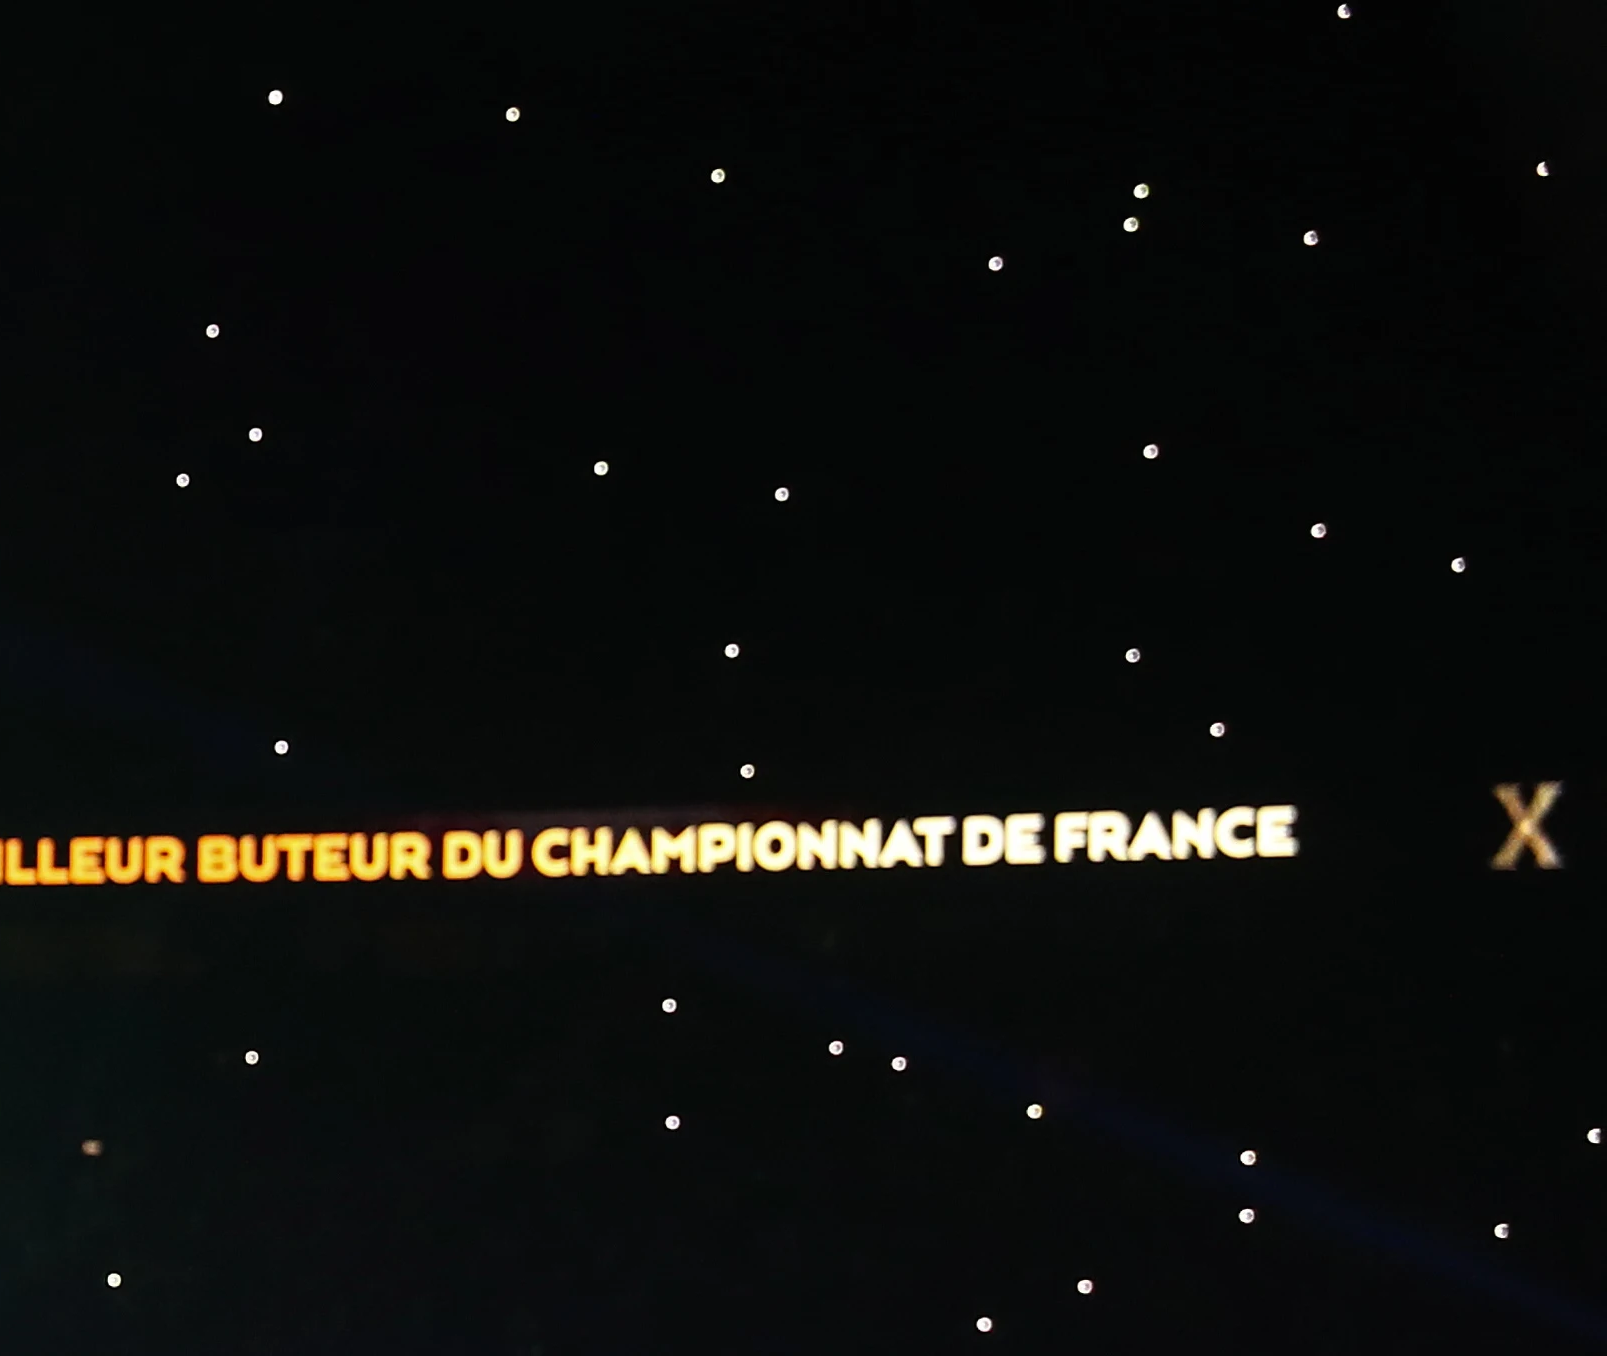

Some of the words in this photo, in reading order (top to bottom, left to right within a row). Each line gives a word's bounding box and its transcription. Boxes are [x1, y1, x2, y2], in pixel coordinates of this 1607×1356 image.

[195, 830, 434, 886] BUTEUR
[440, 827, 525, 881] DU
[529, 815, 958, 879] CHAMPIONNAT
[960, 811, 1047, 867] DE
[1052, 803, 1299, 865] FRANCE
[1491, 781, 1563, 870] X
